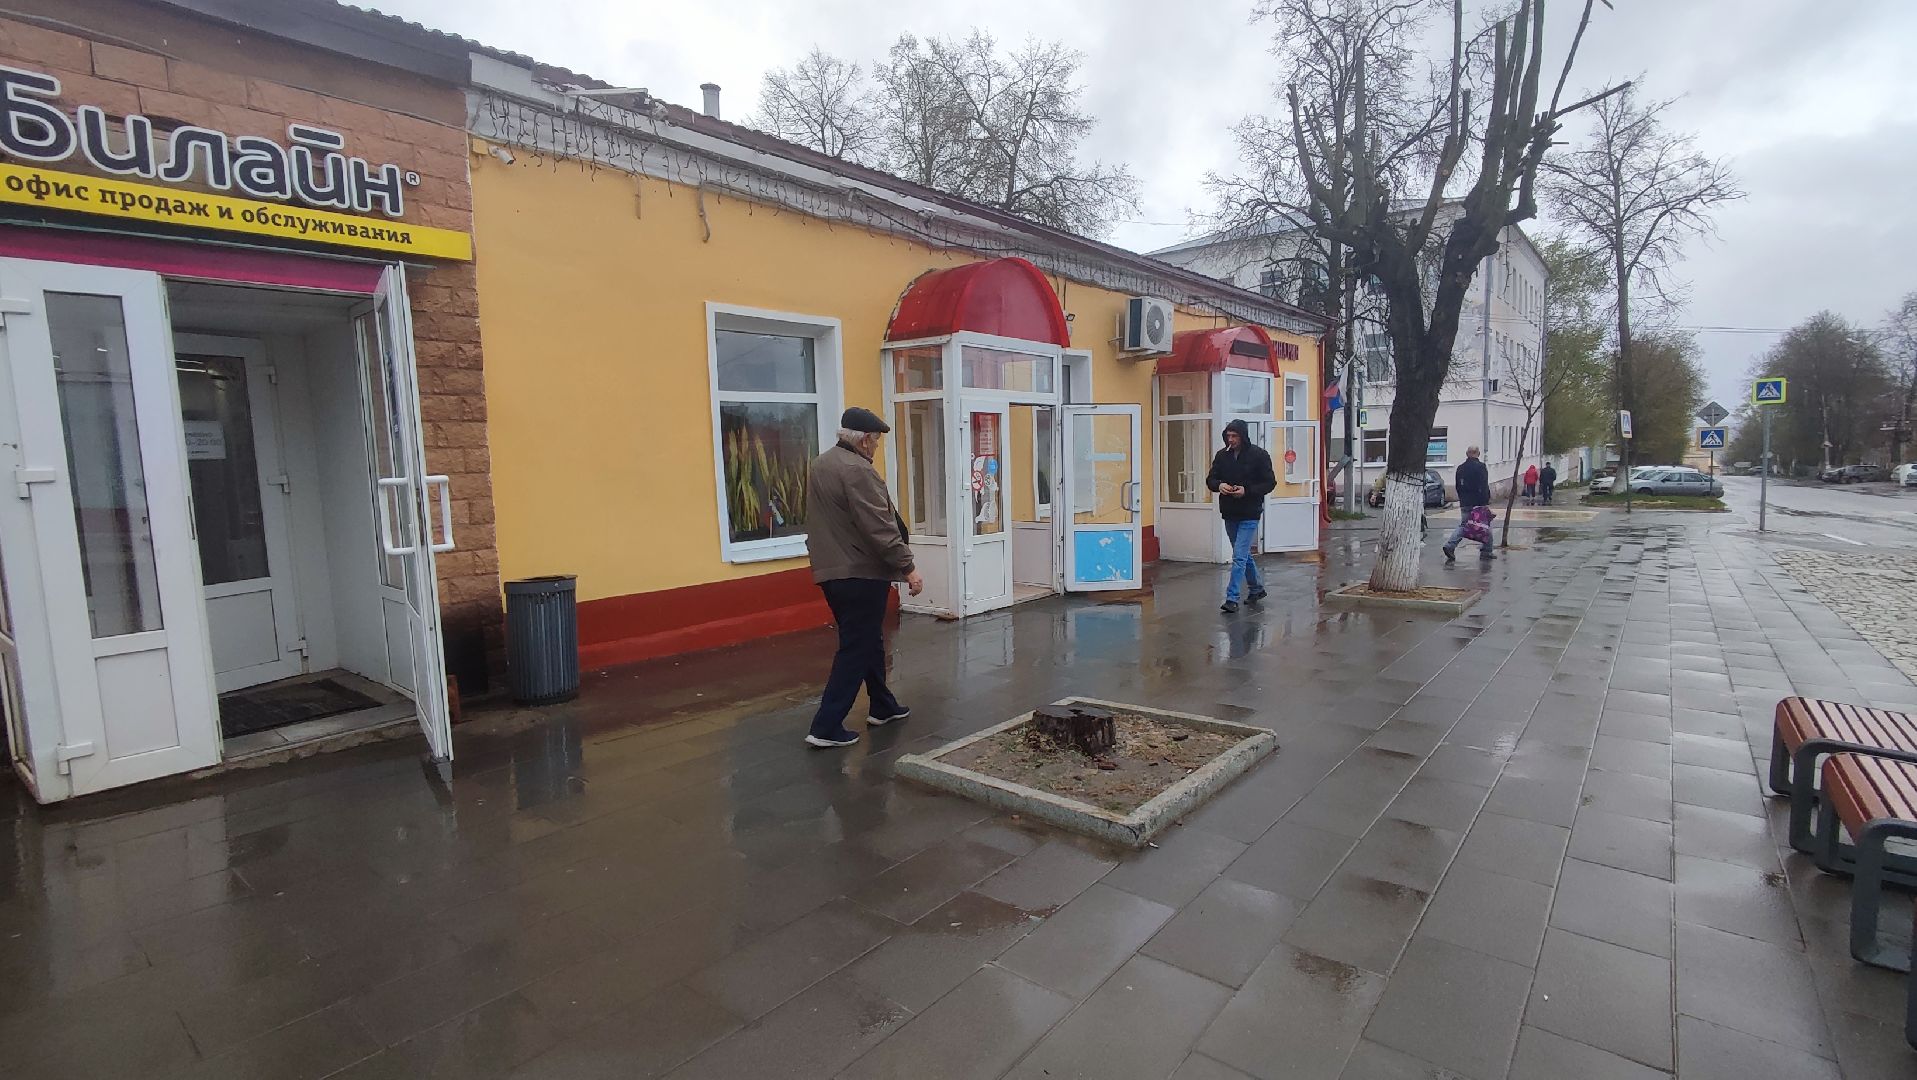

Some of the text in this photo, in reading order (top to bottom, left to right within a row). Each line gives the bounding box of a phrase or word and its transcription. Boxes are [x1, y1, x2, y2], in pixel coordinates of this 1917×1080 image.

[5, 173, 413, 245] офис продаж и обслуживания
